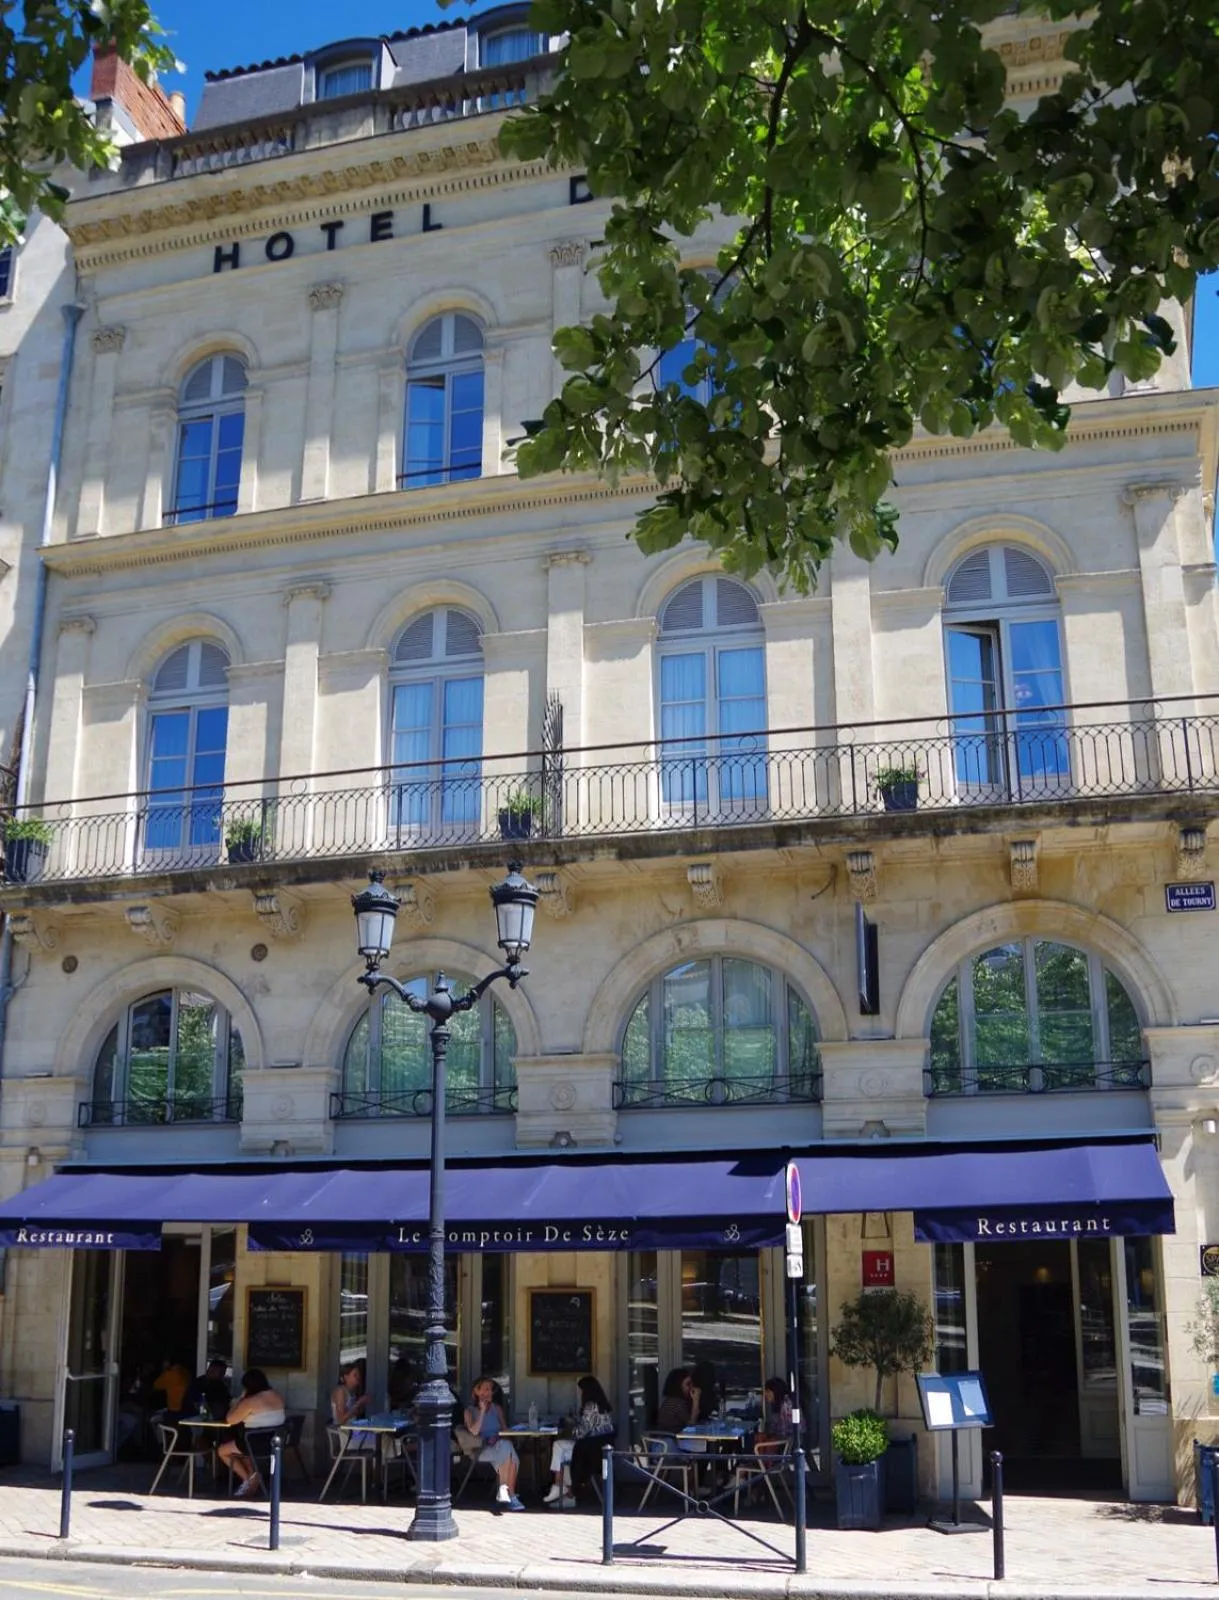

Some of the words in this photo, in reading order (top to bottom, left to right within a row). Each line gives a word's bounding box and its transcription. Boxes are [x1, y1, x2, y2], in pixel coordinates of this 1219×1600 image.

[213, 203, 443, 273] HOTEL
[1170, 898, 1181, 907] DE
[1182, 897, 1211, 907] TOURNY
[978, 1216, 1112, 1236] Restaurant
[17, 1227, 114, 1244] Restaurant
[398, 1226, 421, 1243] Le
[436, 1227, 533, 1248] omptoir
[544, 1225, 571, 1243] De
[582, 1224, 630, 1242] Sèze
[876, 1258, 890, 1272] H
